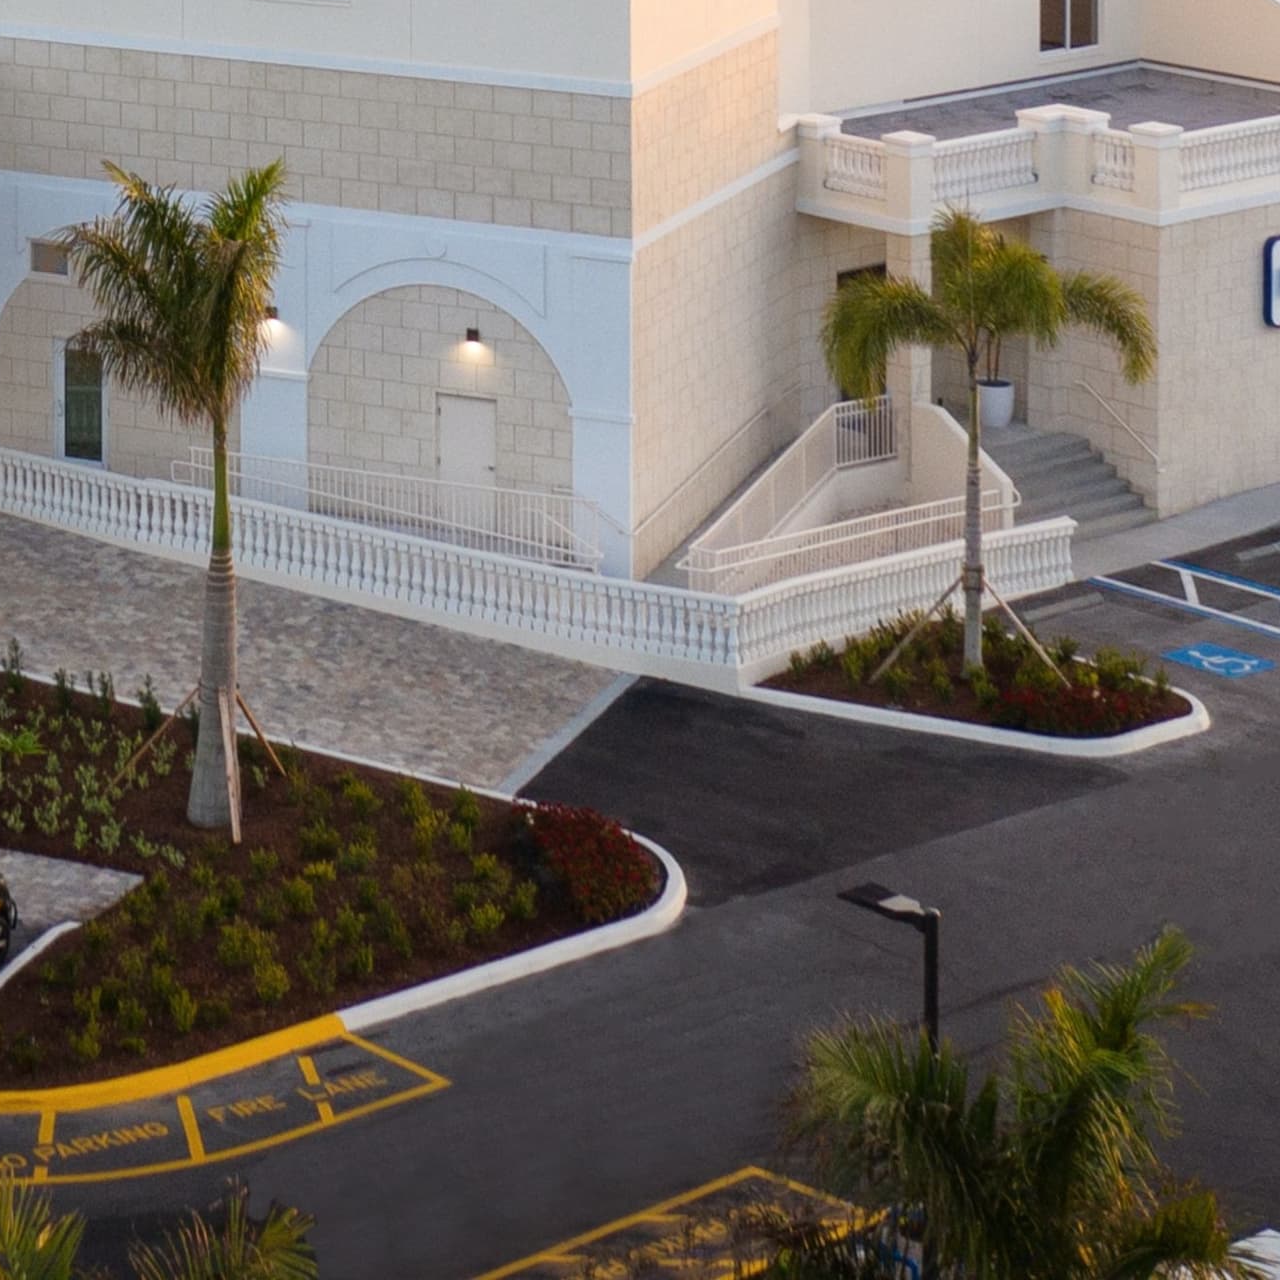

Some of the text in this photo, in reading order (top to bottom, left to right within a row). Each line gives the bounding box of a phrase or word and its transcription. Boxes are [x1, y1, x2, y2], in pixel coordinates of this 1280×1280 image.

[34, 1121, 169, 1161] PARKING
[207, 1095, 286, 1124] FIRE
[297, 1069, 388, 1101] LANE
